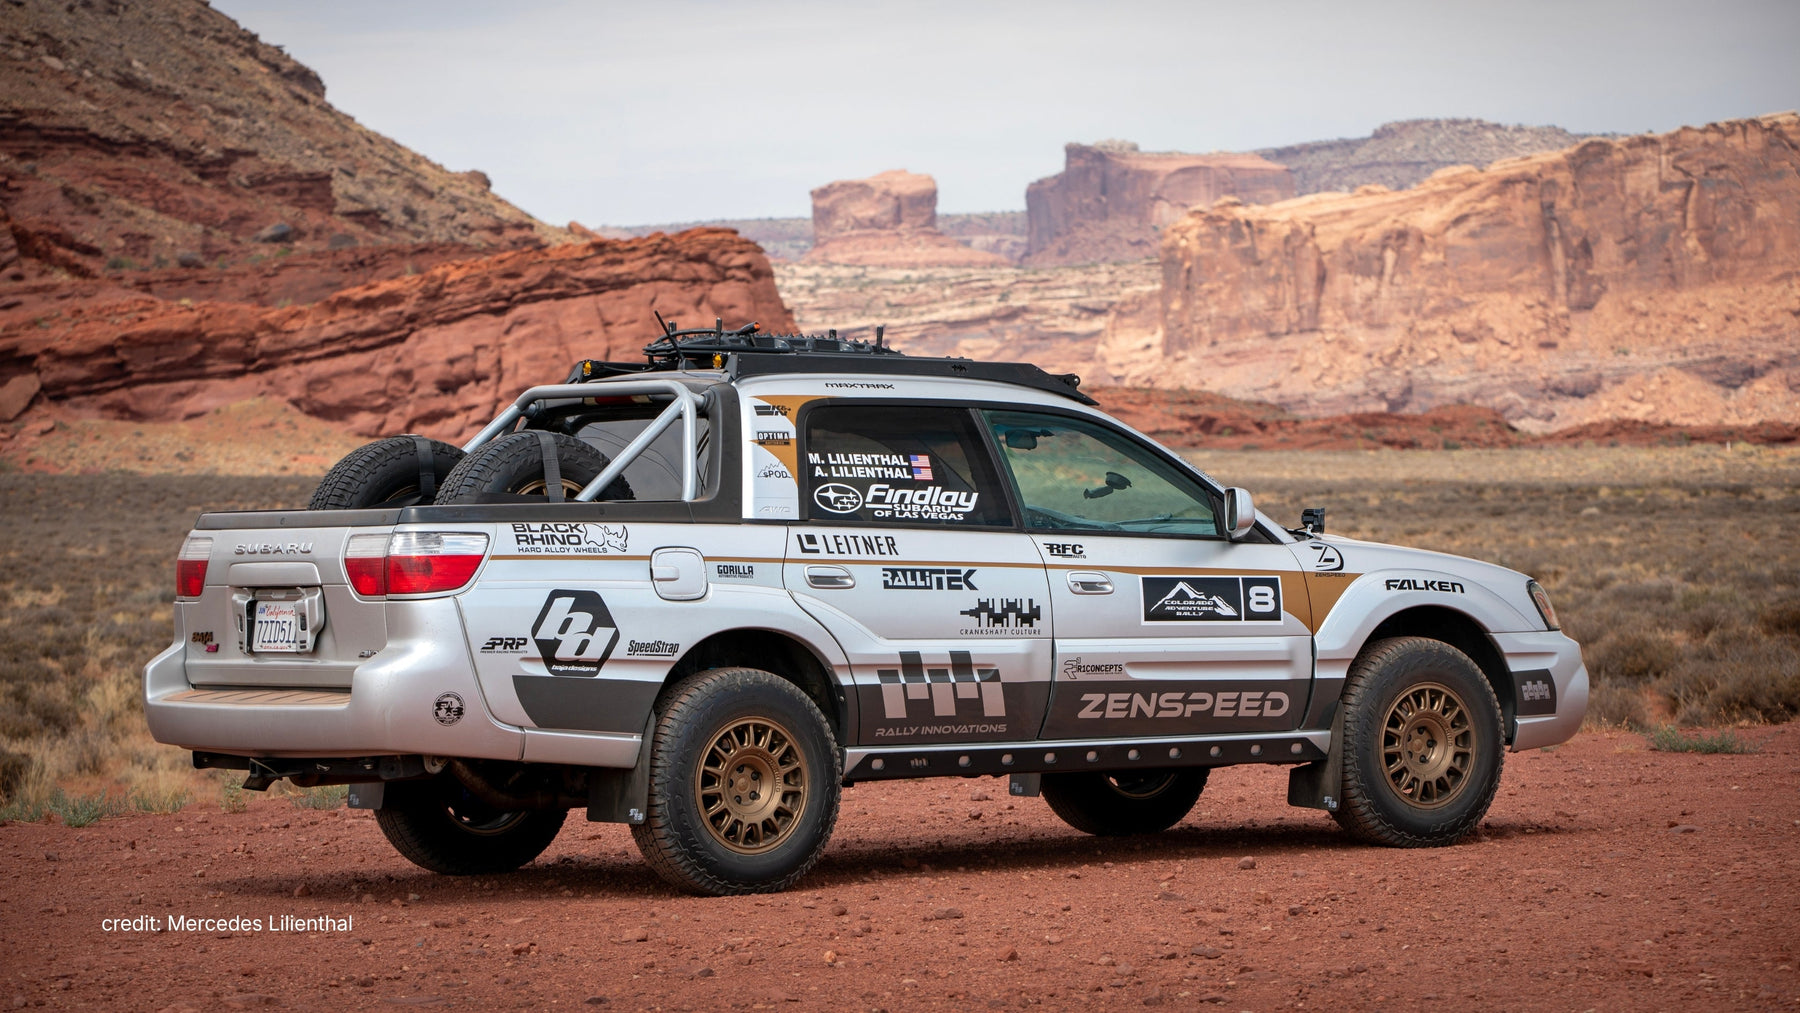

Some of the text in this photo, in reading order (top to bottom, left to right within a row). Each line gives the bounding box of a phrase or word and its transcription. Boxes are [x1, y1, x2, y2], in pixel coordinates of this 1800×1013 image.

[825, 382, 895, 390] MAXTRAX
[758, 432, 789, 440] OPTIMA
[808, 453, 909, 466] M. LILIENTHAL
[814, 466, 912, 479] A. LILIENTHAL
[865, 484, 979, 511] Findlay
[894, 504, 953, 513] SUBARU
[896, 511, 919, 519] LAS
[921, 512, 964, 521] VEGAS
[511, 523, 585, 533] BLACK
[515, 534, 582, 546] RHINO
[821, 534, 900, 556] LEITNER
[234, 542, 314, 555] SUBARU
[1043, 543, 1084, 554] RFC
[717, 565, 754, 575] GORILLA
[1385, 579, 1465, 594] FALKEN
[1248, 585, 1276, 613] 8
[266, 605, 296, 619] California
[959, 628, 1041, 636] CRANKSHAFT CULTURE
[481, 637, 528, 650] PRP
[628, 640, 679, 654] SpeedStrap
[1077, 664, 1123, 673] R1CONCEPTS
[1077, 691, 1290, 719] ZENSPEED
[875, 723, 1007, 737] RALLY INNOVATIONS
